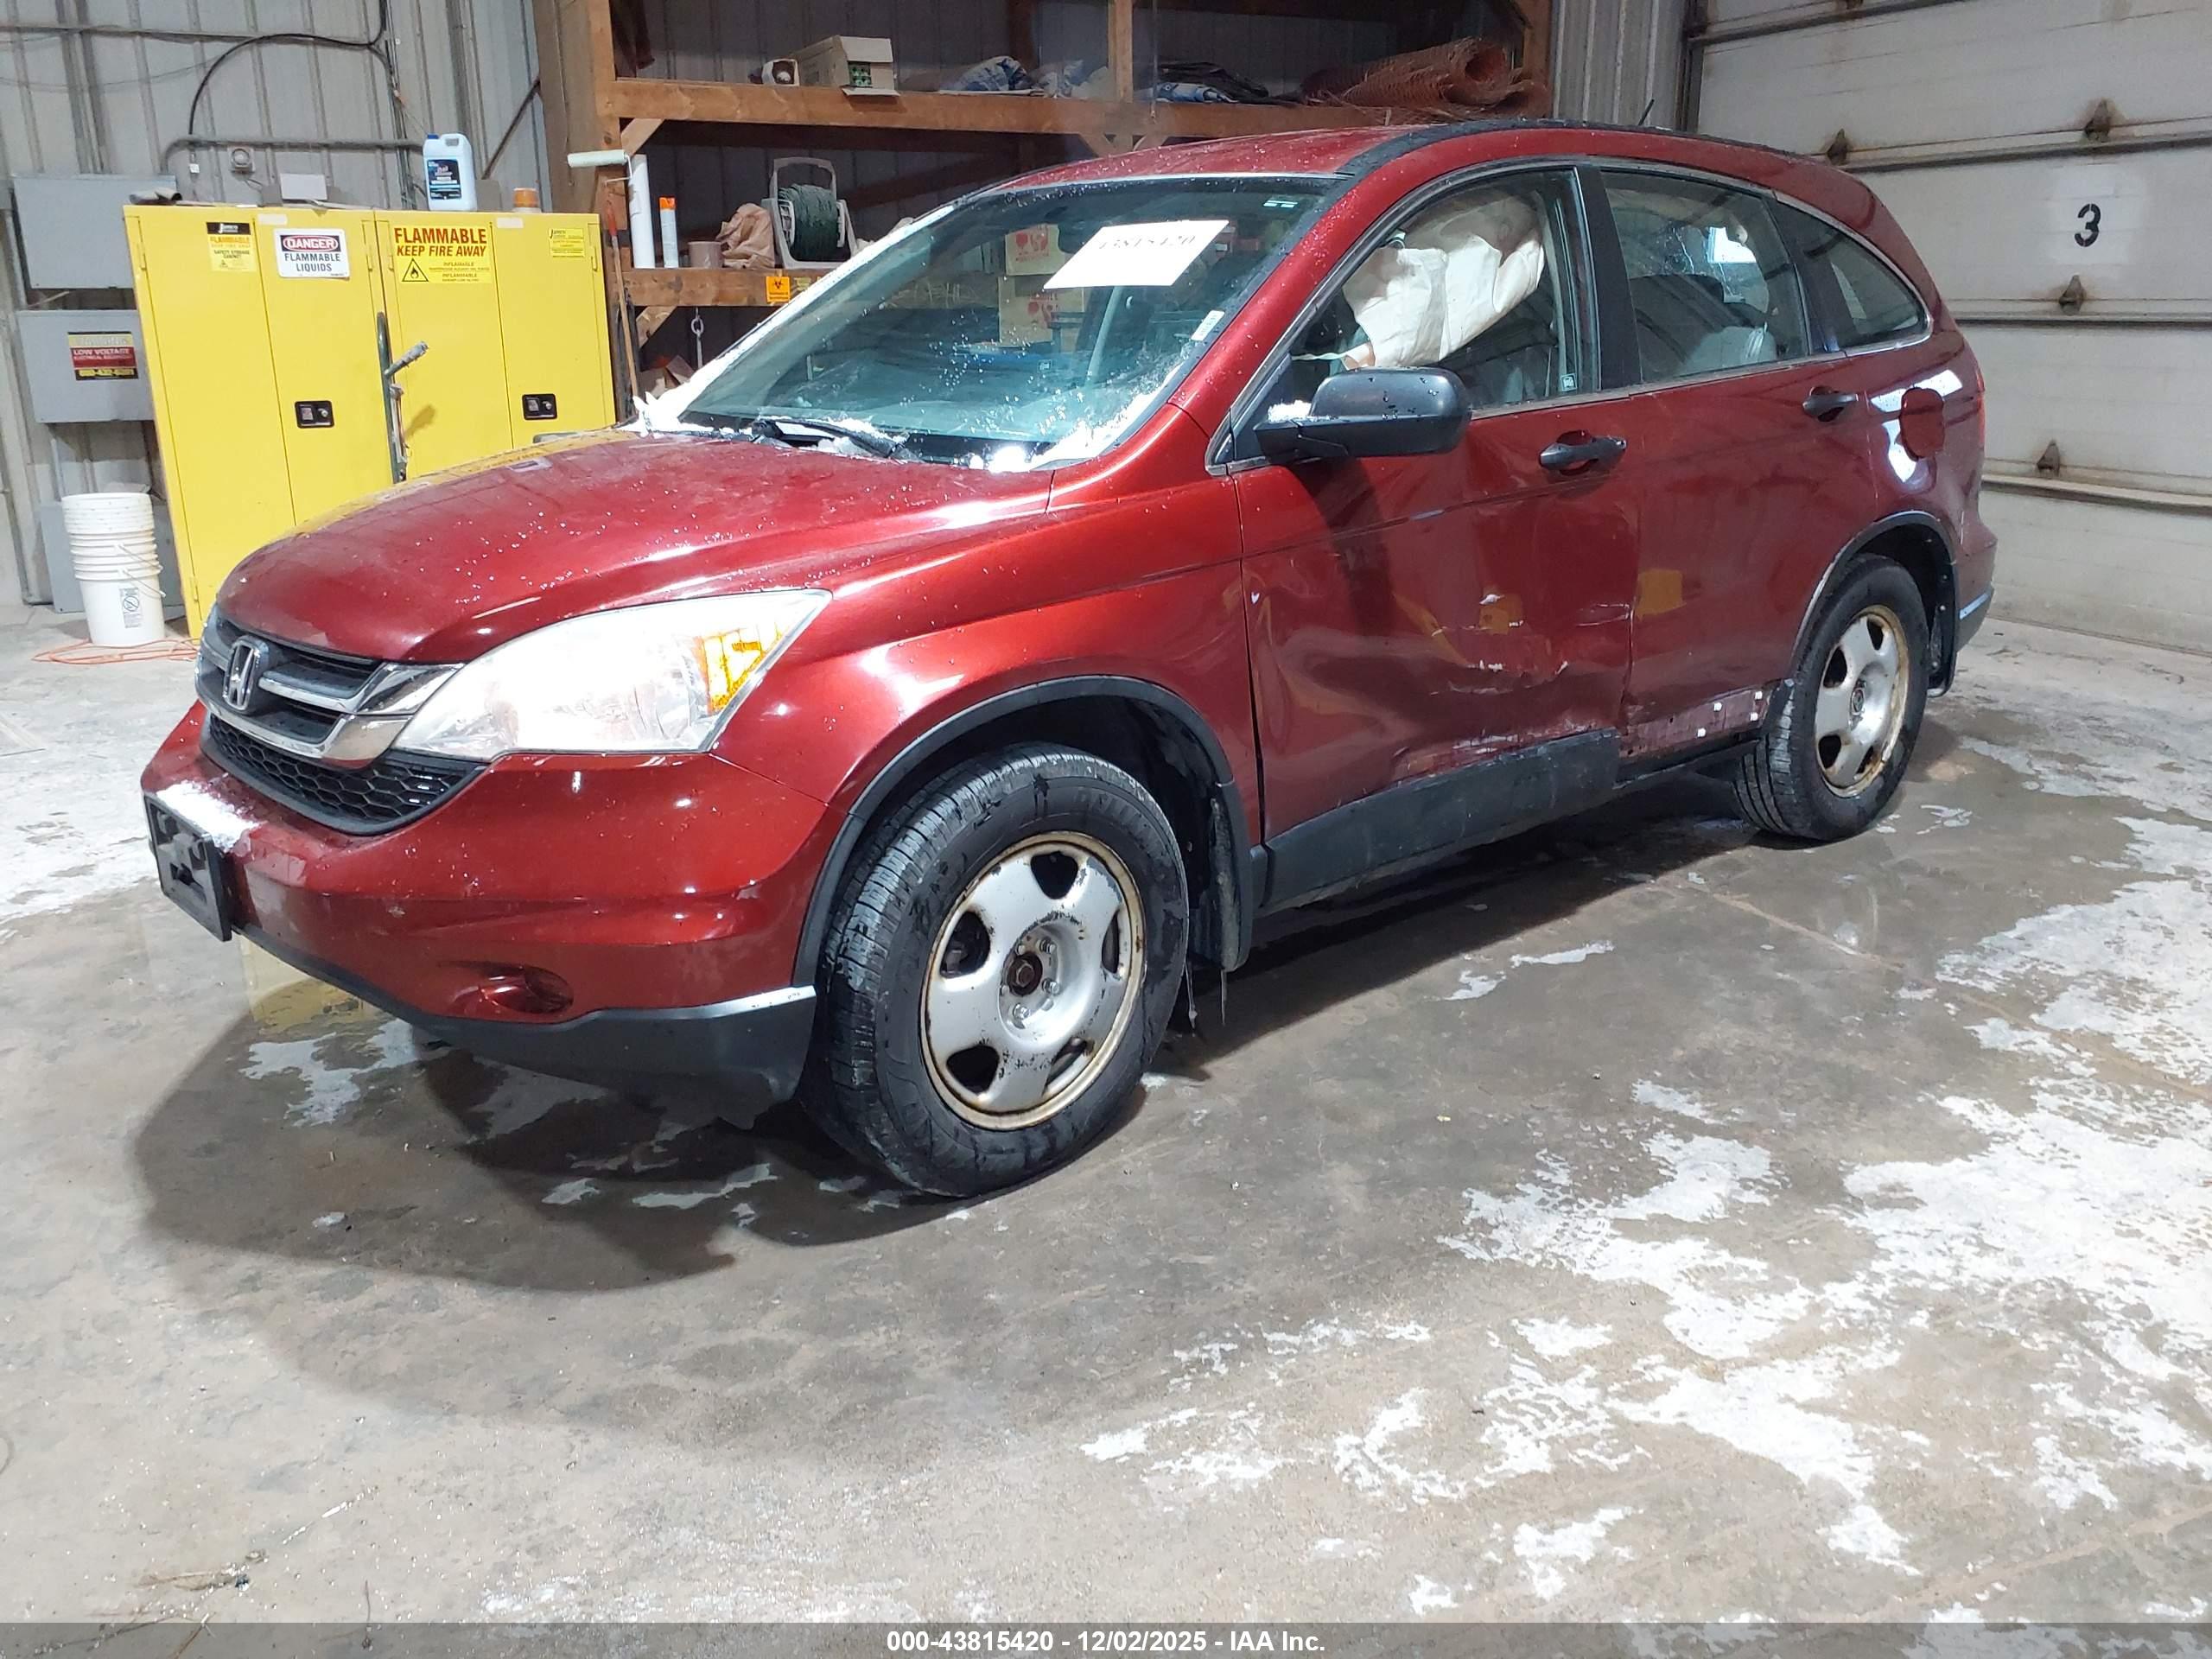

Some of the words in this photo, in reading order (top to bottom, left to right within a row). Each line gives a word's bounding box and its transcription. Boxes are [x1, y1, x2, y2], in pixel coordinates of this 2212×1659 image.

[2074, 203, 2101, 247] 3
[394, 227, 487, 245] FLAMMABLE
[286, 238, 334, 249] DANGER
[397, 245, 425, 257] KEEP
[429, 245, 454, 257] FIRE
[455, 245, 487, 257] AWAY
[284, 252, 340, 262] FLAMMABLE
[296, 263, 333, 272] LIQUIDS
